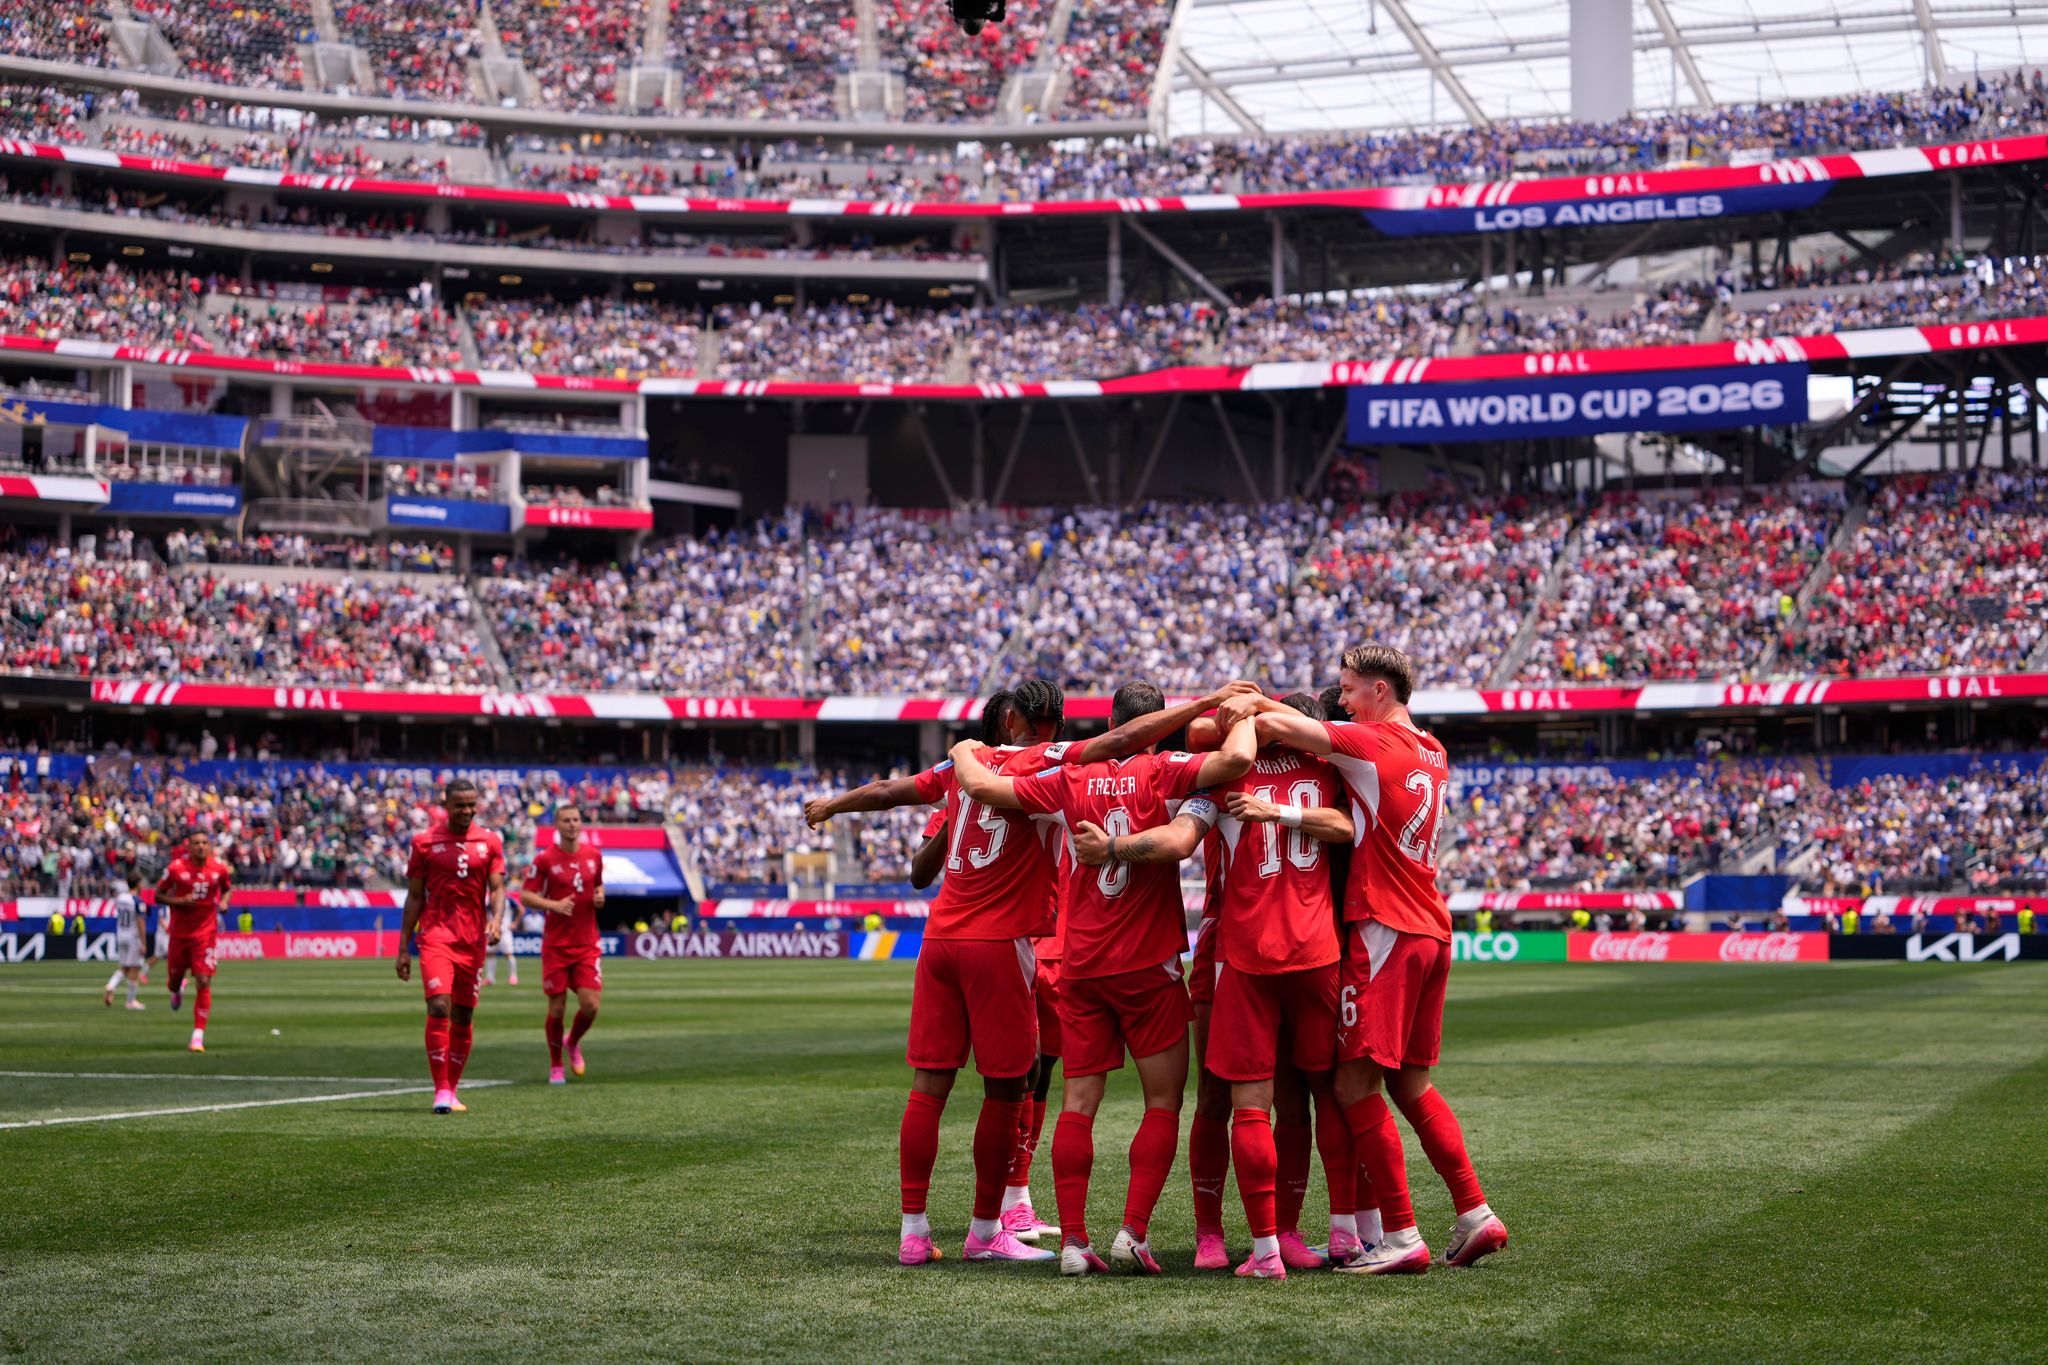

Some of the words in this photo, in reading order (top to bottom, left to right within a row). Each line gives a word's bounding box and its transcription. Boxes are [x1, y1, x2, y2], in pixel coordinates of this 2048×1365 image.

[1939, 142, 2004, 166] GOAL
[1586, 173, 1648, 196] GOAL
[1475, 207, 1546, 231] LOS
[1553, 195, 1724, 225] ANGELES
[1949, 322, 2018, 347] GOAL
[1525, 353, 1590, 374] GOAL
[1368, 397, 1444, 428] FIFA
[1447, 393, 1576, 425] WORLD
[1580, 388, 1653, 419] CUP
[1657, 379, 1784, 416] 2026
[274, 686, 343, 710] GOAL
[1927, 675, 2003, 698] GOAL
[684, 697, 757, 719] GOAL
[1501, 689, 1572, 711] GOAL
[946, 786, 1010, 874] 15
[1252, 779, 1323, 880] 10
[285, 933, 358, 958] Lenovo
[635, 932, 721, 960] QATAR
[729, 932, 841, 958] AIRWAYS
[1905, 932, 2021, 962] KIA
